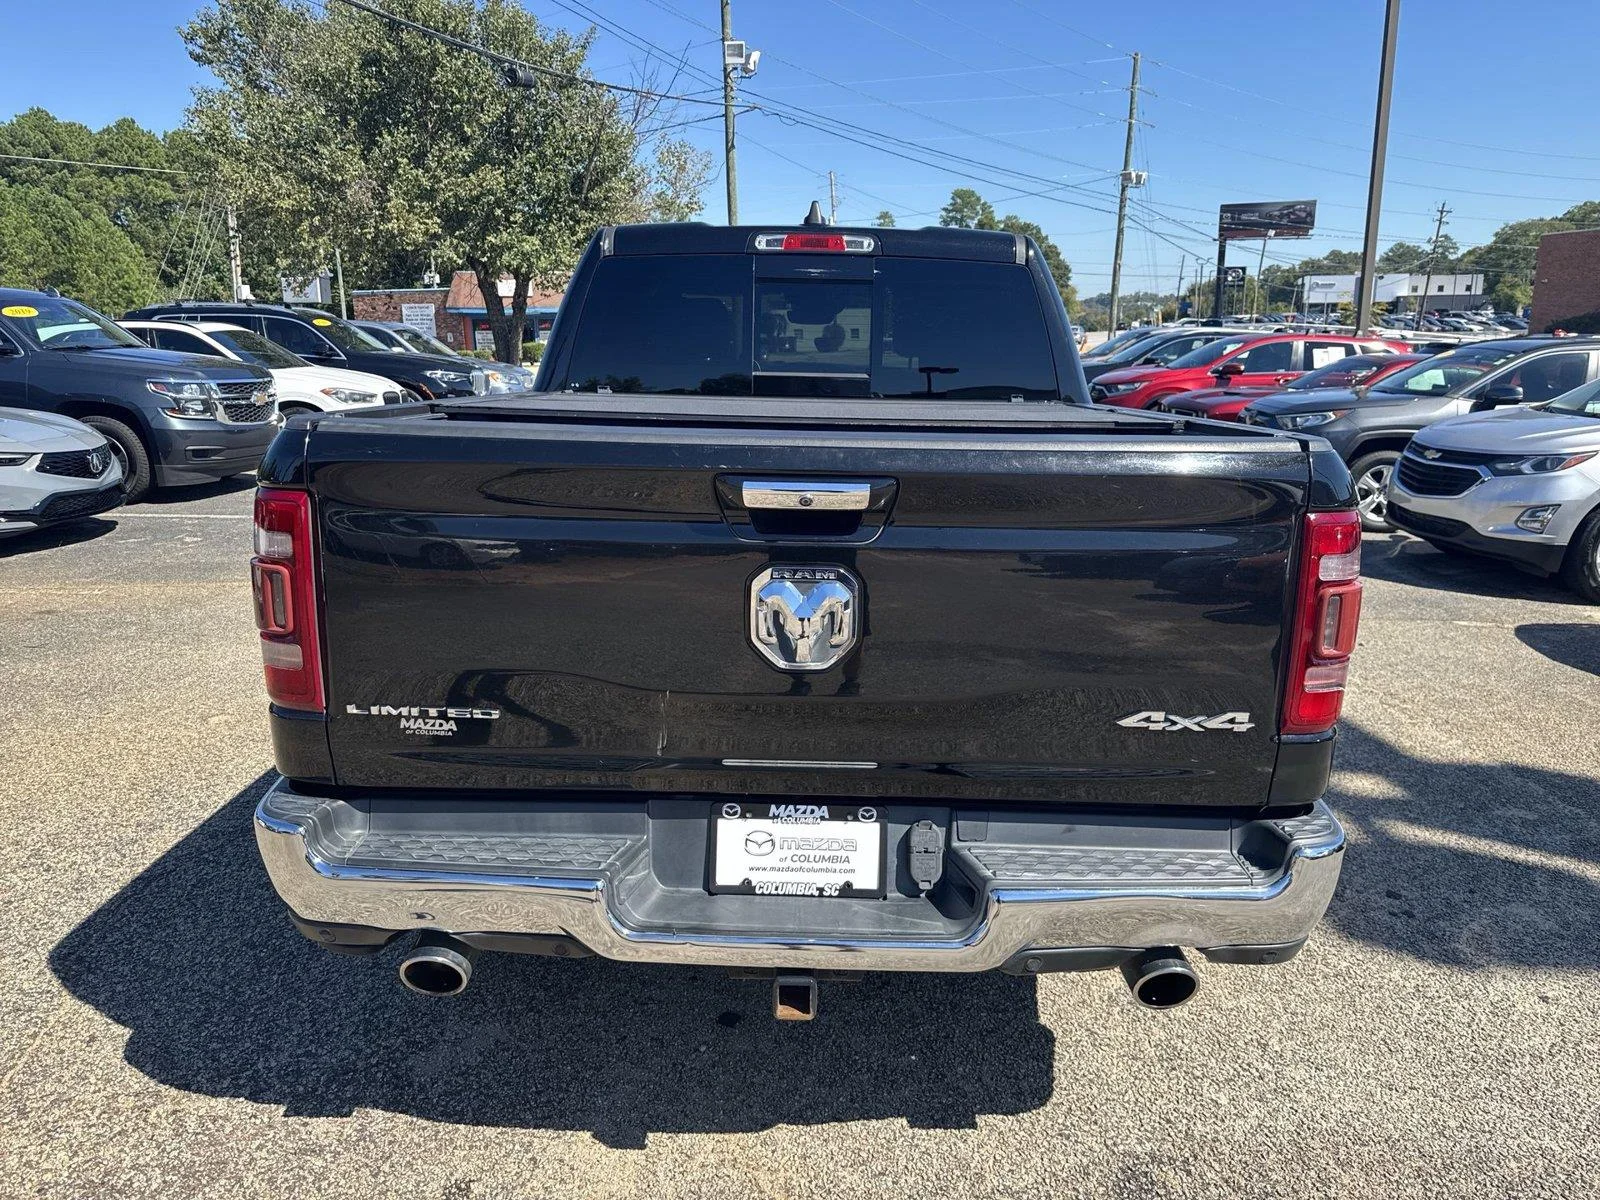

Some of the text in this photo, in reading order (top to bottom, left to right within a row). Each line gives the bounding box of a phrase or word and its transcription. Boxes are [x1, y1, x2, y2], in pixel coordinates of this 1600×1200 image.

[772, 569, 838, 579] RAM
[346, 704, 500, 719] LIMITED
[400, 717, 458, 731] MAZDA
[769, 804, 829, 818] MAZDA
[779, 837, 857, 851] mazda
[790, 854, 850, 864] COLUMBIA
[749, 865, 855, 874] www.mazdaofcolumbia.com
[755, 881, 840, 896] COLUMBIA, SC
